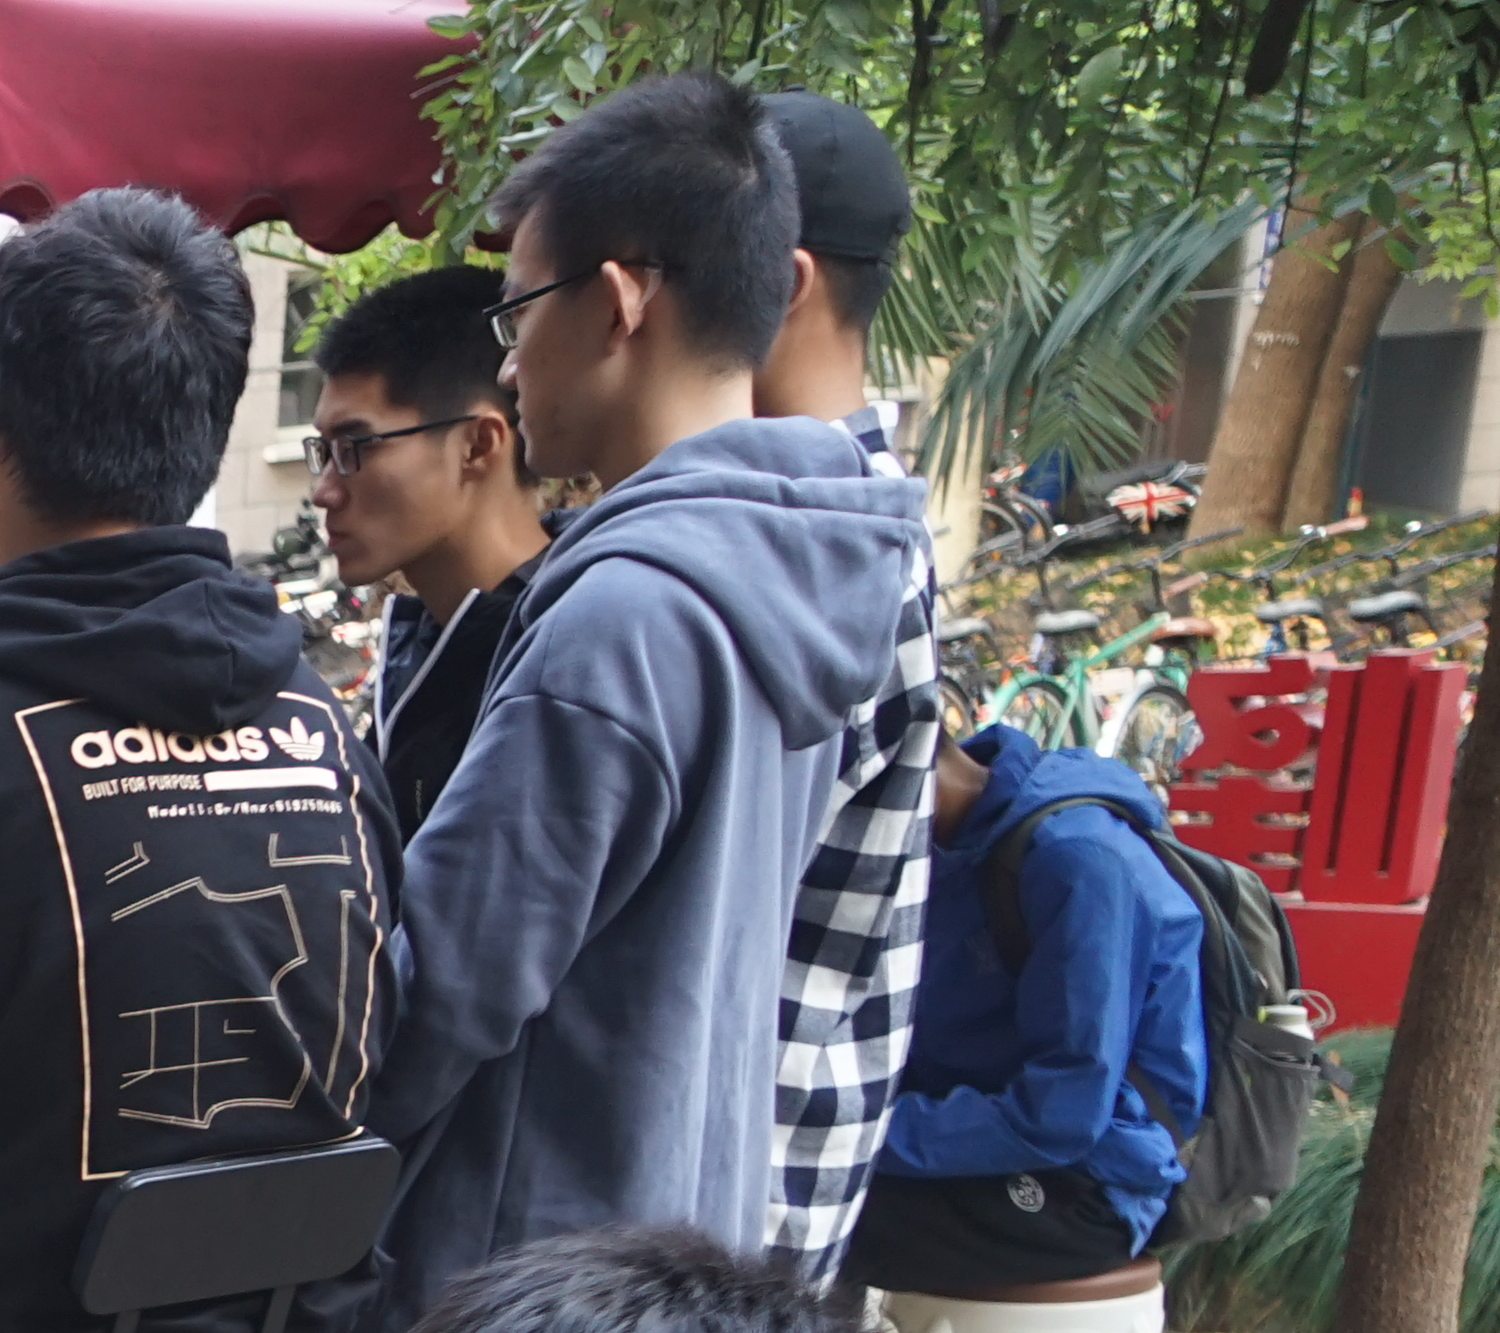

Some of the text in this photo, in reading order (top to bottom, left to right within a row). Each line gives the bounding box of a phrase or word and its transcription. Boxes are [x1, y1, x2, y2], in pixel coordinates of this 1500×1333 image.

[70, 722, 270, 770] adidas
[82, 774, 205, 801] BUILT FOR PURPOSE
